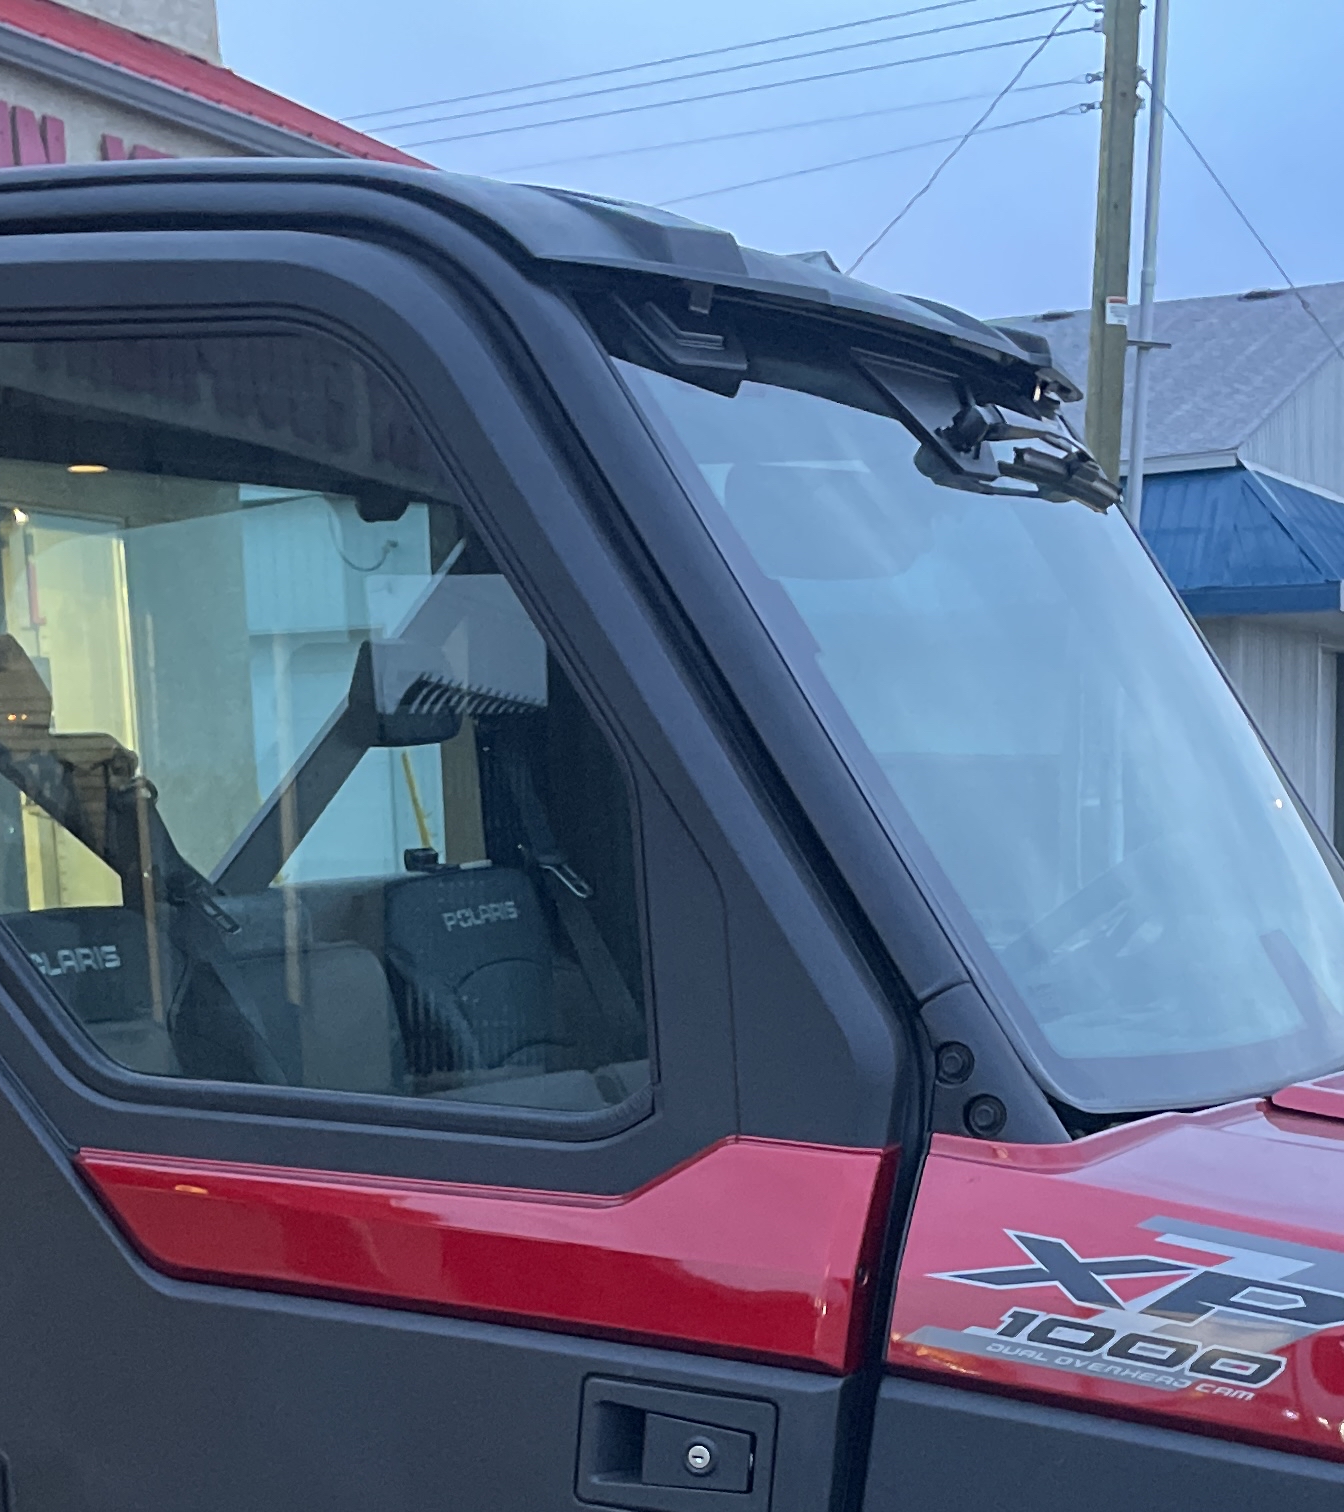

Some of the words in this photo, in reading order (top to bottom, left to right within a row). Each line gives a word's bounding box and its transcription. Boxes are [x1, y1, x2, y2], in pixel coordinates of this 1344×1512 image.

[440, 900, 518, 932] POLARIS
[986, 1342, 1049, 1363] DUAL
[1053, 1355, 1192, 1388] OVERHEAD
[1194, 1382, 1257, 1402] CAM
[992, 1307, 1288, 1389] 1000
